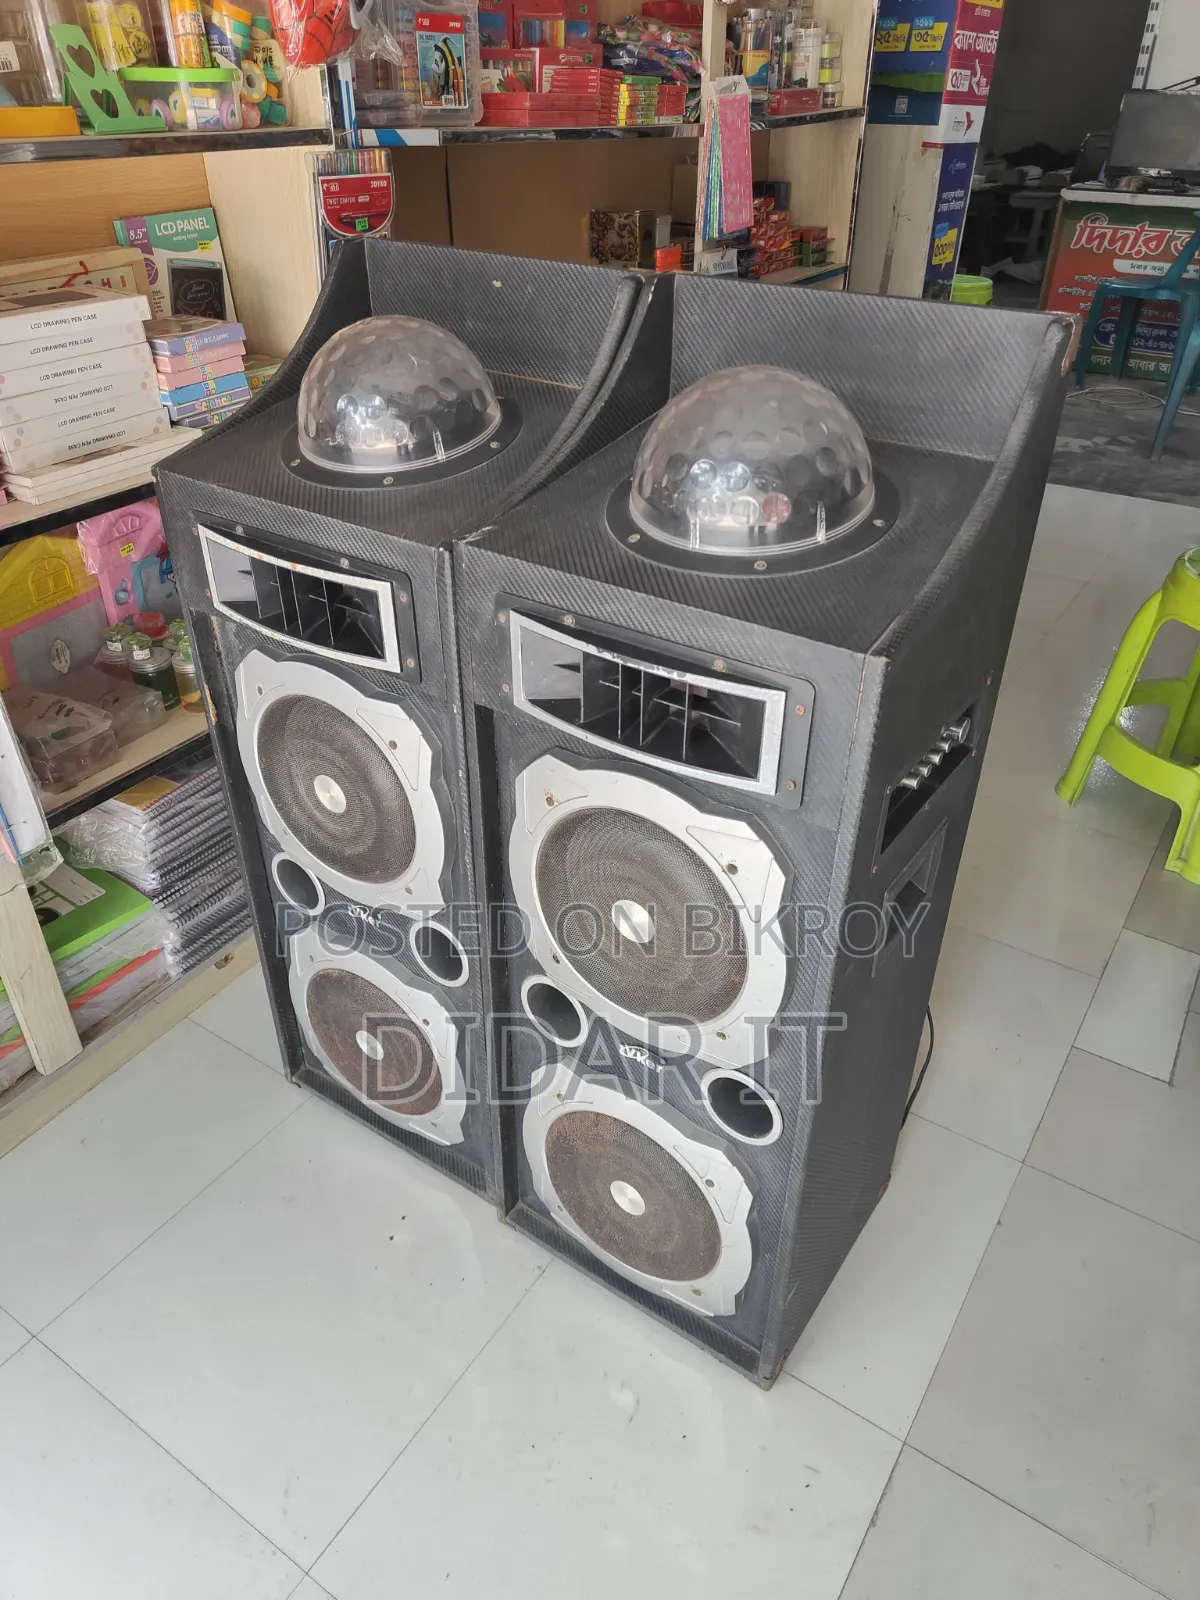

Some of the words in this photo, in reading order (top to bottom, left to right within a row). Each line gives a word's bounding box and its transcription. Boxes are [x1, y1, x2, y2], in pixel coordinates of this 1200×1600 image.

[914, 31, 930, 43] ৩৫
[155, 221, 176, 236] LCD
[177, 216, 210, 232] PANEL
[1071, 213, 1171, 258] দিদার
[43, 318, 70, 328] DRAWING
[42, 342, 68, 352] DRAWING
[51, 368, 77, 378] DRAWING
[89, 362, 102, 370] CASE
[1127, 358, 1158, 372] আবার
[80, 387, 102, 398] DRAWING
[69, 414, 92, 424] DRAWING
[92, 433, 116, 444] DRAWING
